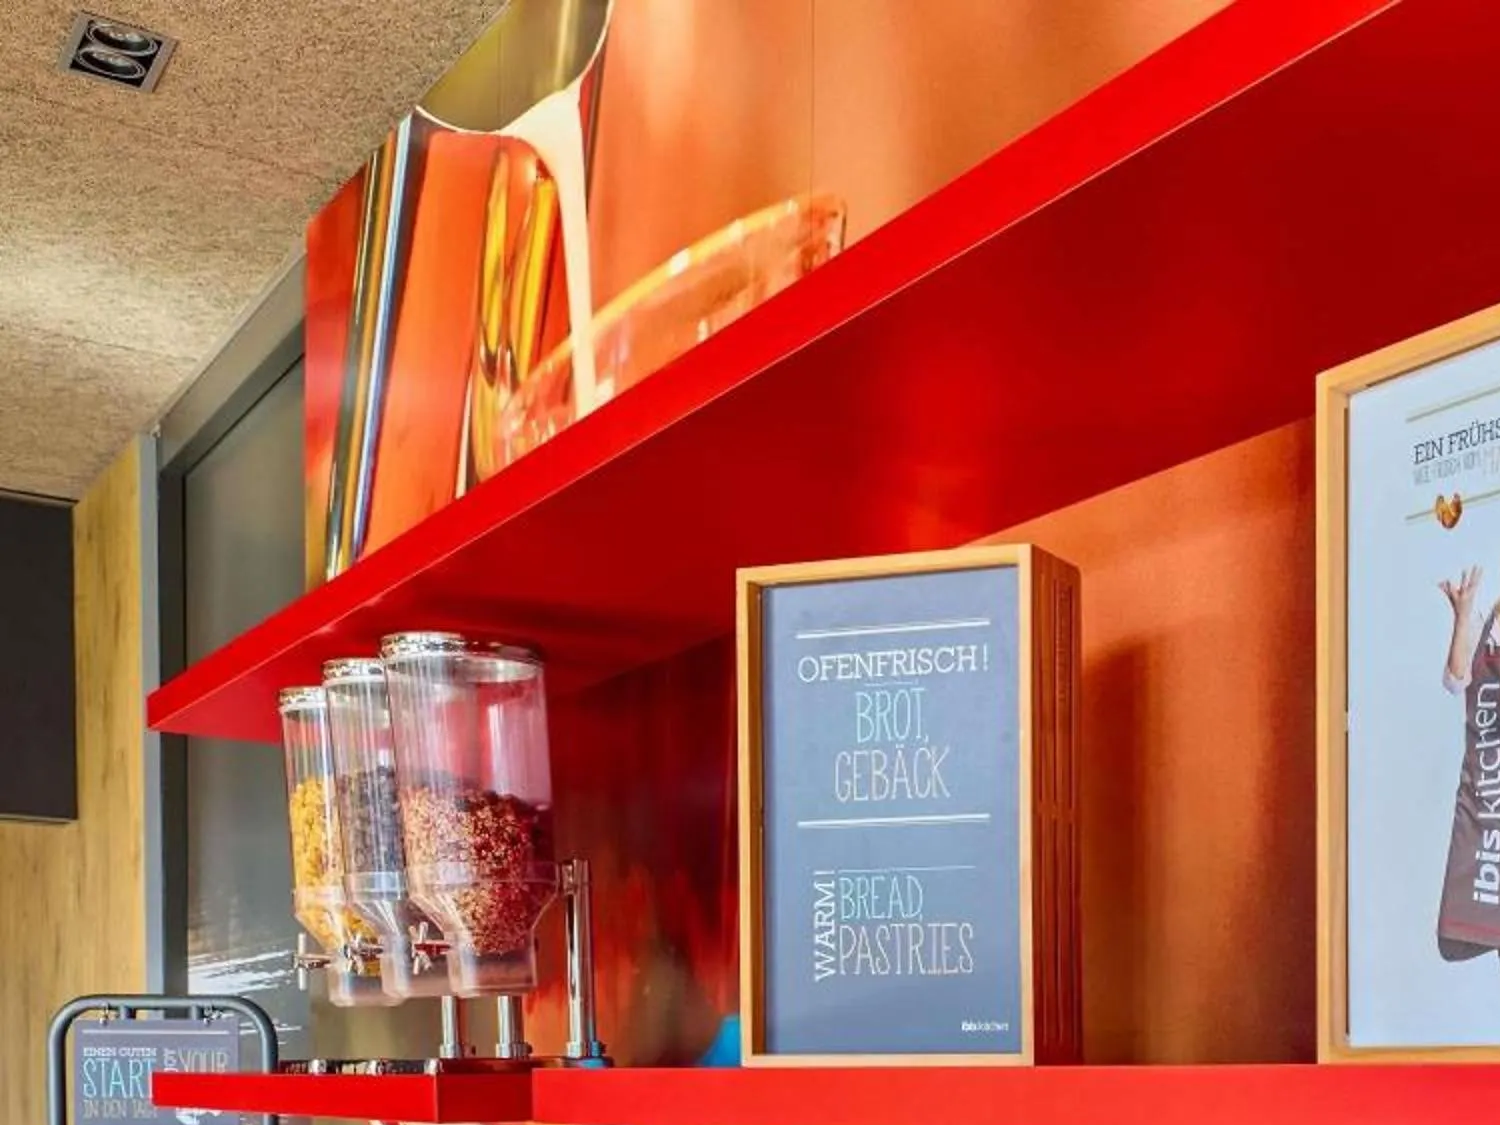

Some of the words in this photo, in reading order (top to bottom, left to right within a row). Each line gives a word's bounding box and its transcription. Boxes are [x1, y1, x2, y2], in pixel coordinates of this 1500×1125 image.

[1413, 437, 1443, 465] EIN
[798, 644, 989, 683] OFENFRISCH!
[834, 743, 950, 802] GEBÄCK
[839, 922, 974, 976] PASTRIES
[83, 1057, 157, 1099] START
